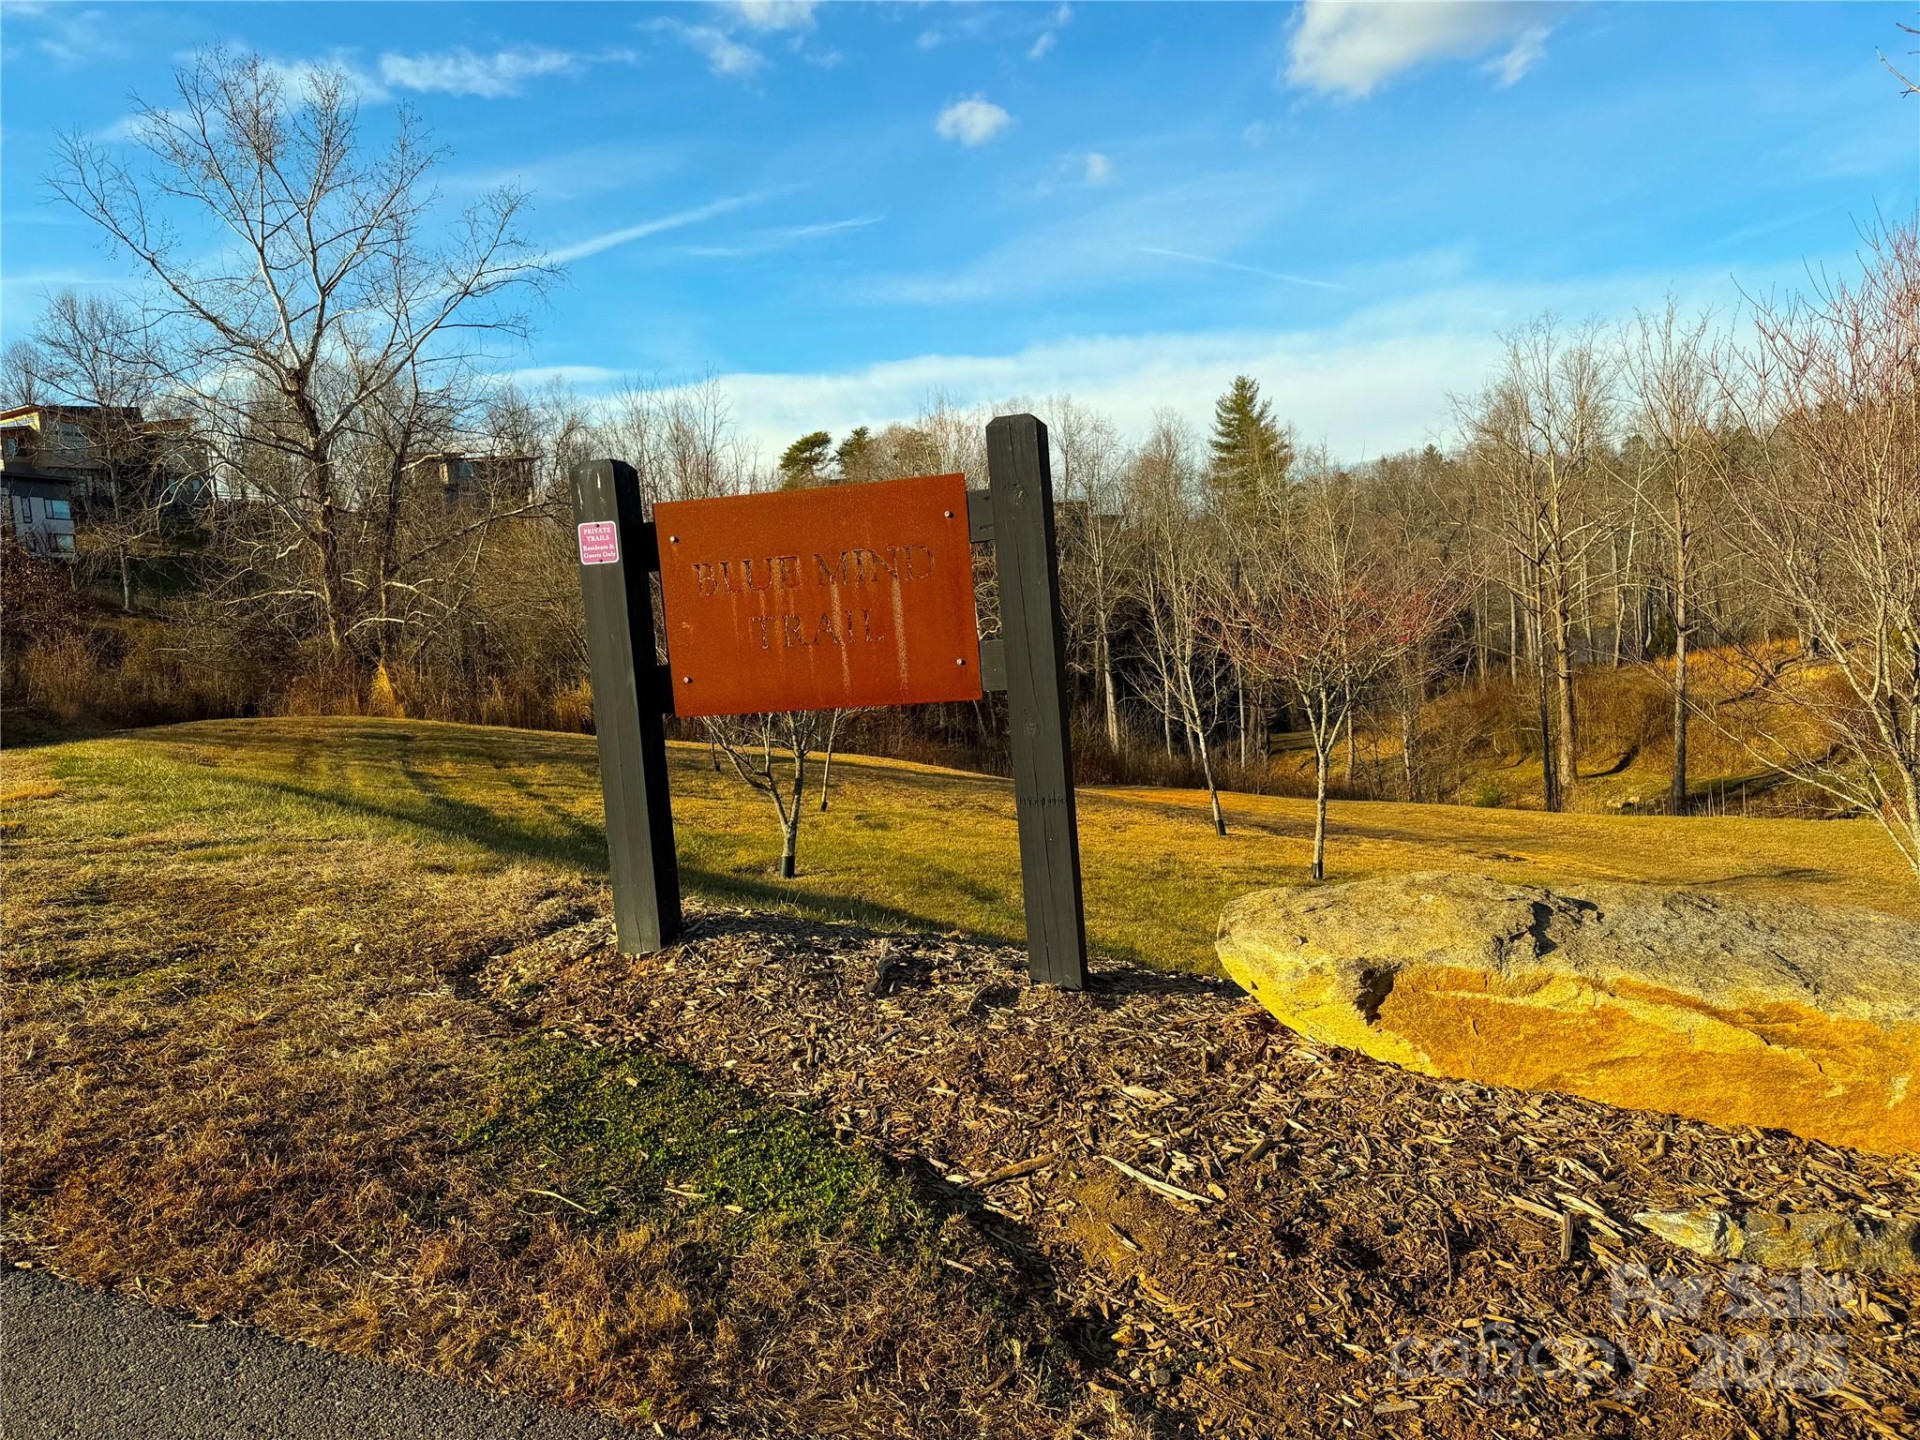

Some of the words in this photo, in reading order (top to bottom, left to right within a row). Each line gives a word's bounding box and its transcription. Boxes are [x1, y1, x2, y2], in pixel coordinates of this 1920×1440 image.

[583, 527, 611, 535] PRIVATE
[586, 534, 610, 542] TRAILS
[692, 554, 802, 597] BLUE
[812, 545, 935, 587] MIND
[749, 607, 885, 650] TRAIL
